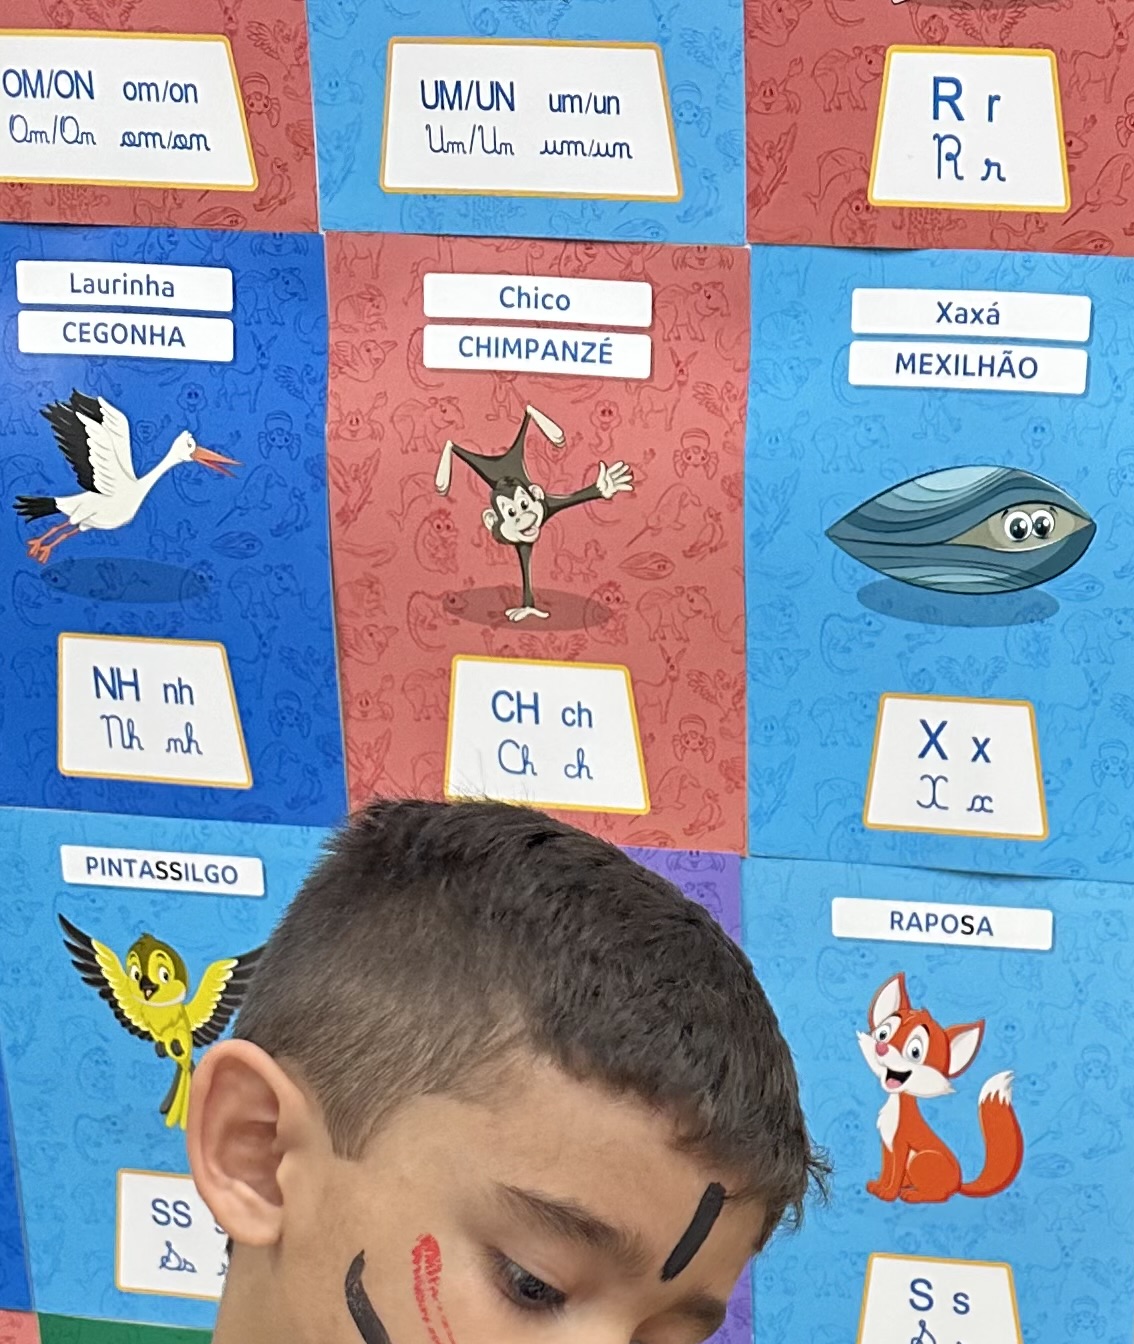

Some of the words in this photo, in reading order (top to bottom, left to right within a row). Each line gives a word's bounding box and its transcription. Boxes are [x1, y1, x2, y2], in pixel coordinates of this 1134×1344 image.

[1, 68, 95, 101] OM/ON
[122, 79, 199, 105] om/on
[420, 78, 516, 112] UM/UN
[548, 91, 621, 116] um/un
[932, 75, 966, 122] R
[987, 94, 1002, 123] r
[69, 272, 175, 298] Laurinha
[499, 284, 571, 312] Chico
[935, 300, 1001, 326] Xaxá
[62, 321, 187, 348] CEGONHA
[458, 335, 613, 365] CHIMPANZÉ
[895, 349, 1039, 380] MEXILHÃO
[92, 665, 141, 703] NH
[162, 676, 195, 706] nh
[490, 689, 540, 726] CH
[561, 700, 593, 729] ch
[917, 718, 949, 761] X
[970, 736, 992, 764] x
[85, 855, 239, 886] PINTASSILGO
[889, 910, 994, 937] RAPOSA
[150, 1197, 193, 1229] SS
[908, 1277, 935, 1313] S
[952, 1291, 971, 1316] s
